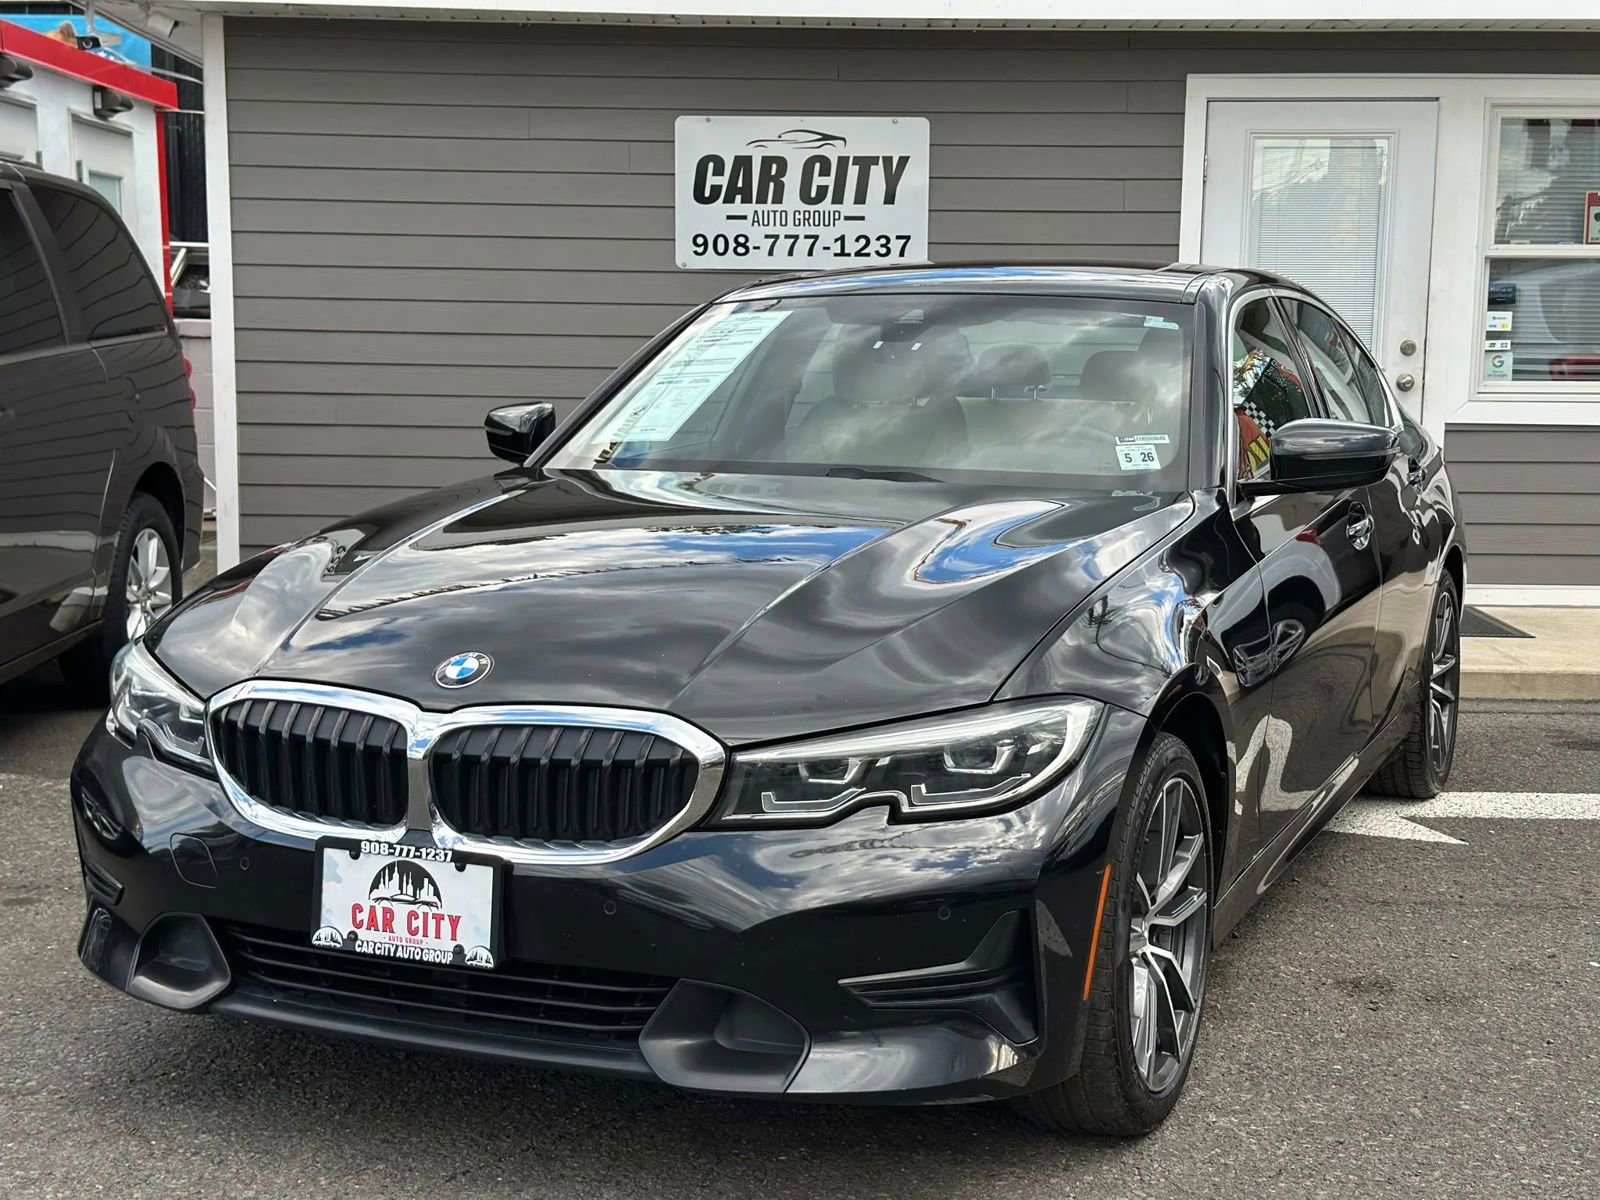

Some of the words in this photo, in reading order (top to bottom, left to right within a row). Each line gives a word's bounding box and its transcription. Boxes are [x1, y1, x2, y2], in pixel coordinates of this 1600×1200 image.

[692, 154, 788, 205] CAR
[799, 154, 911, 206] CITY
[751, 210, 788, 227] AUTO
[793, 210, 841, 228] GROUP
[691, 233, 911, 258] 908-777-1237
[1124, 453, 1133, 463] 5
[1140, 452, 1155, 462] 26
[360, 841, 453, 862] 908-777-1237
[351, 903, 395, 934] CAR
[406, 909, 463, 941] CITY
[388, 935, 403, 943] AUTO
[404, 937, 424, 945] GROUP
[355, 940, 375, 954] CAR
[374, 942, 397, 957] CITY
[396, 945, 422, 960] AUTO
[422, 948, 454, 964] GROUP
